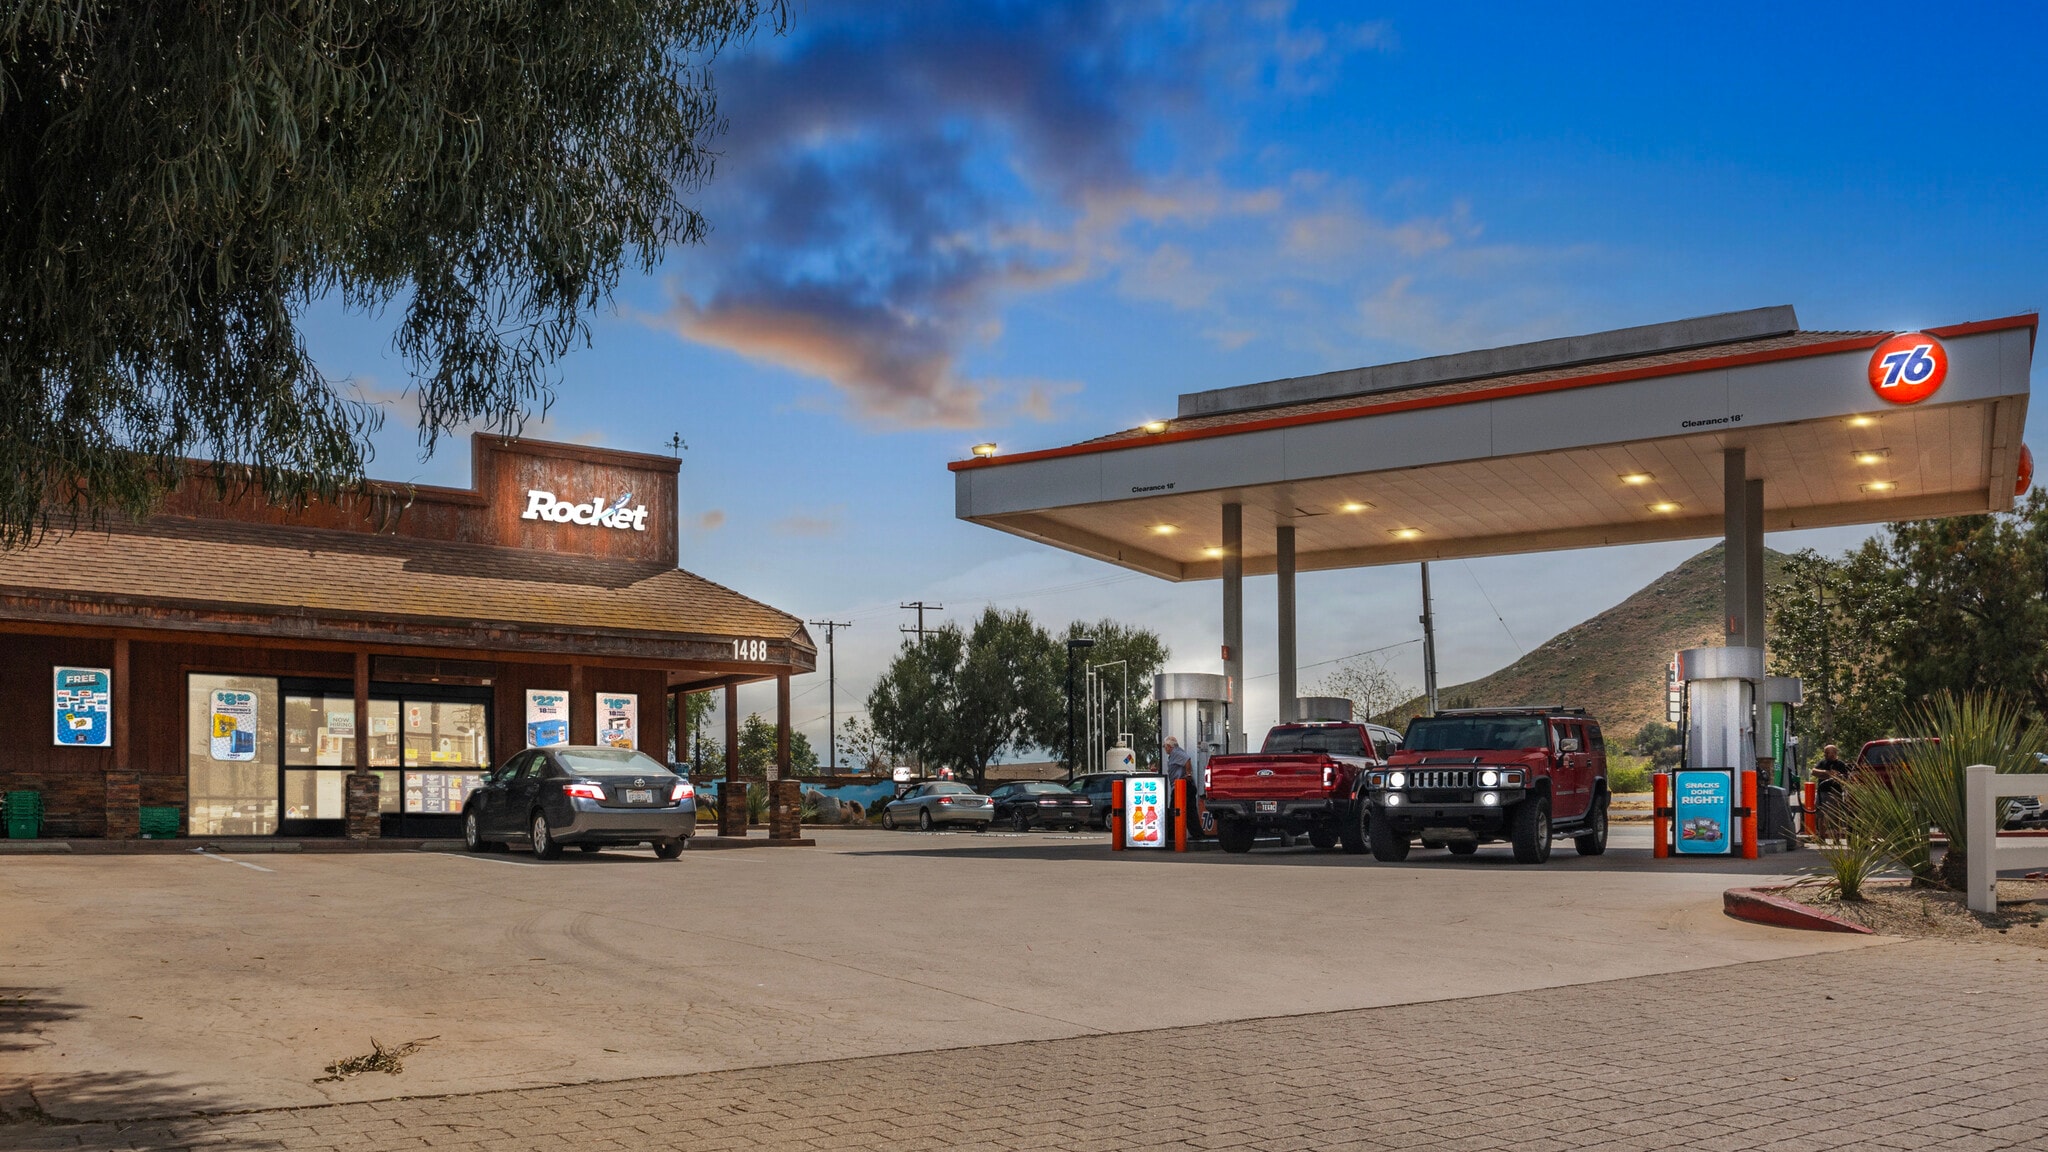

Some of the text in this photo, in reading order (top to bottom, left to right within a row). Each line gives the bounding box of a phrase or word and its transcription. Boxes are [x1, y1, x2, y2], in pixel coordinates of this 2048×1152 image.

[1880, 344, 1935, 388] 76
[1682, 414, 1743, 429] Clearance 18'
[1131, 485, 1166, 493] Clearance
[522, 489, 648, 531] Rocket
[732, 639, 767, 662] 1488
[66, 674, 96, 683] FREE
[1134, 782, 1142, 791] 2
[1134, 795, 1142, 805] 3
[1681, 796, 1724, 804] RIGHT!
[1201, 811, 1215, 832] 76
